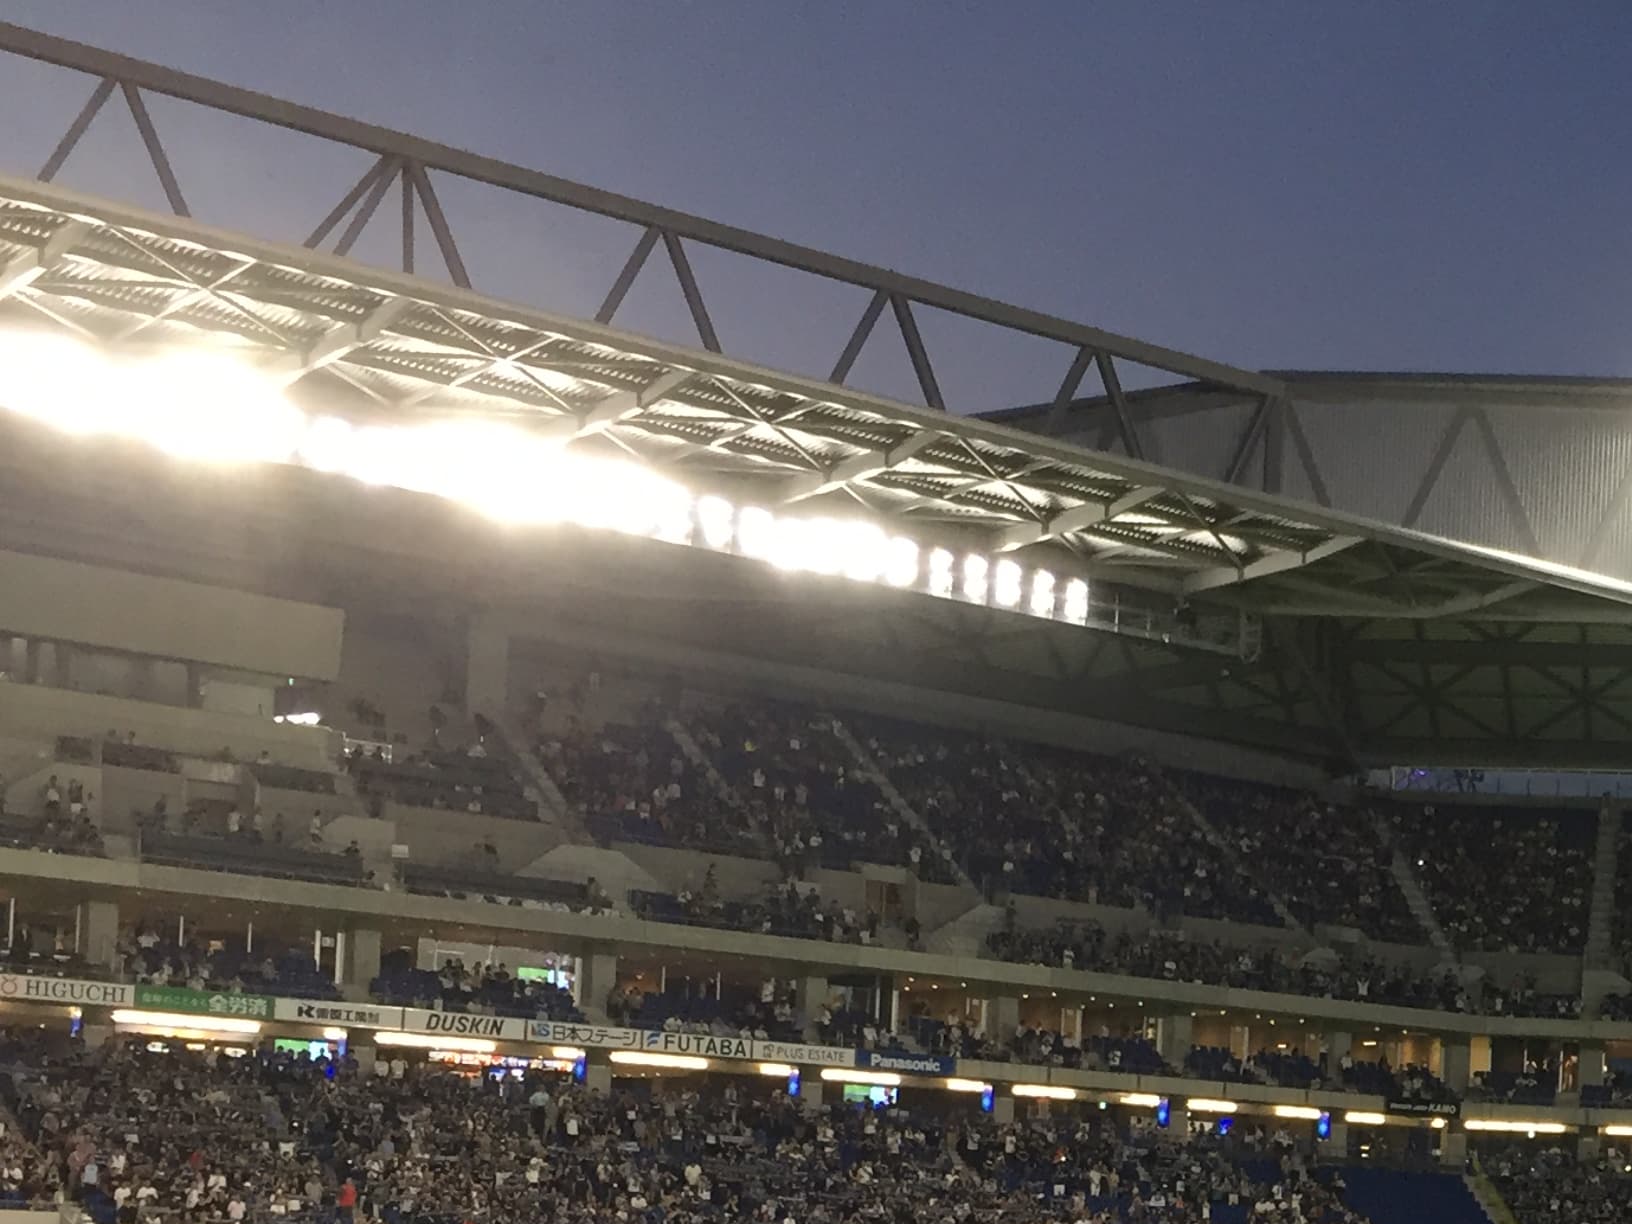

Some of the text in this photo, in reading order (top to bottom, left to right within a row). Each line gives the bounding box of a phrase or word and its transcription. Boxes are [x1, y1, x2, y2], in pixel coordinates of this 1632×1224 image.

[25, 980, 126, 1003] HIGUCHI
[426, 1013, 504, 1036] DUSKIN
[553, 1025, 637, 1046] 日本ステージ
[664, 1034, 747, 1057] FUTABA
[776, 1047, 845, 1063] PLUS ESTATE
[870, 1053, 941, 1072] Panasonic
